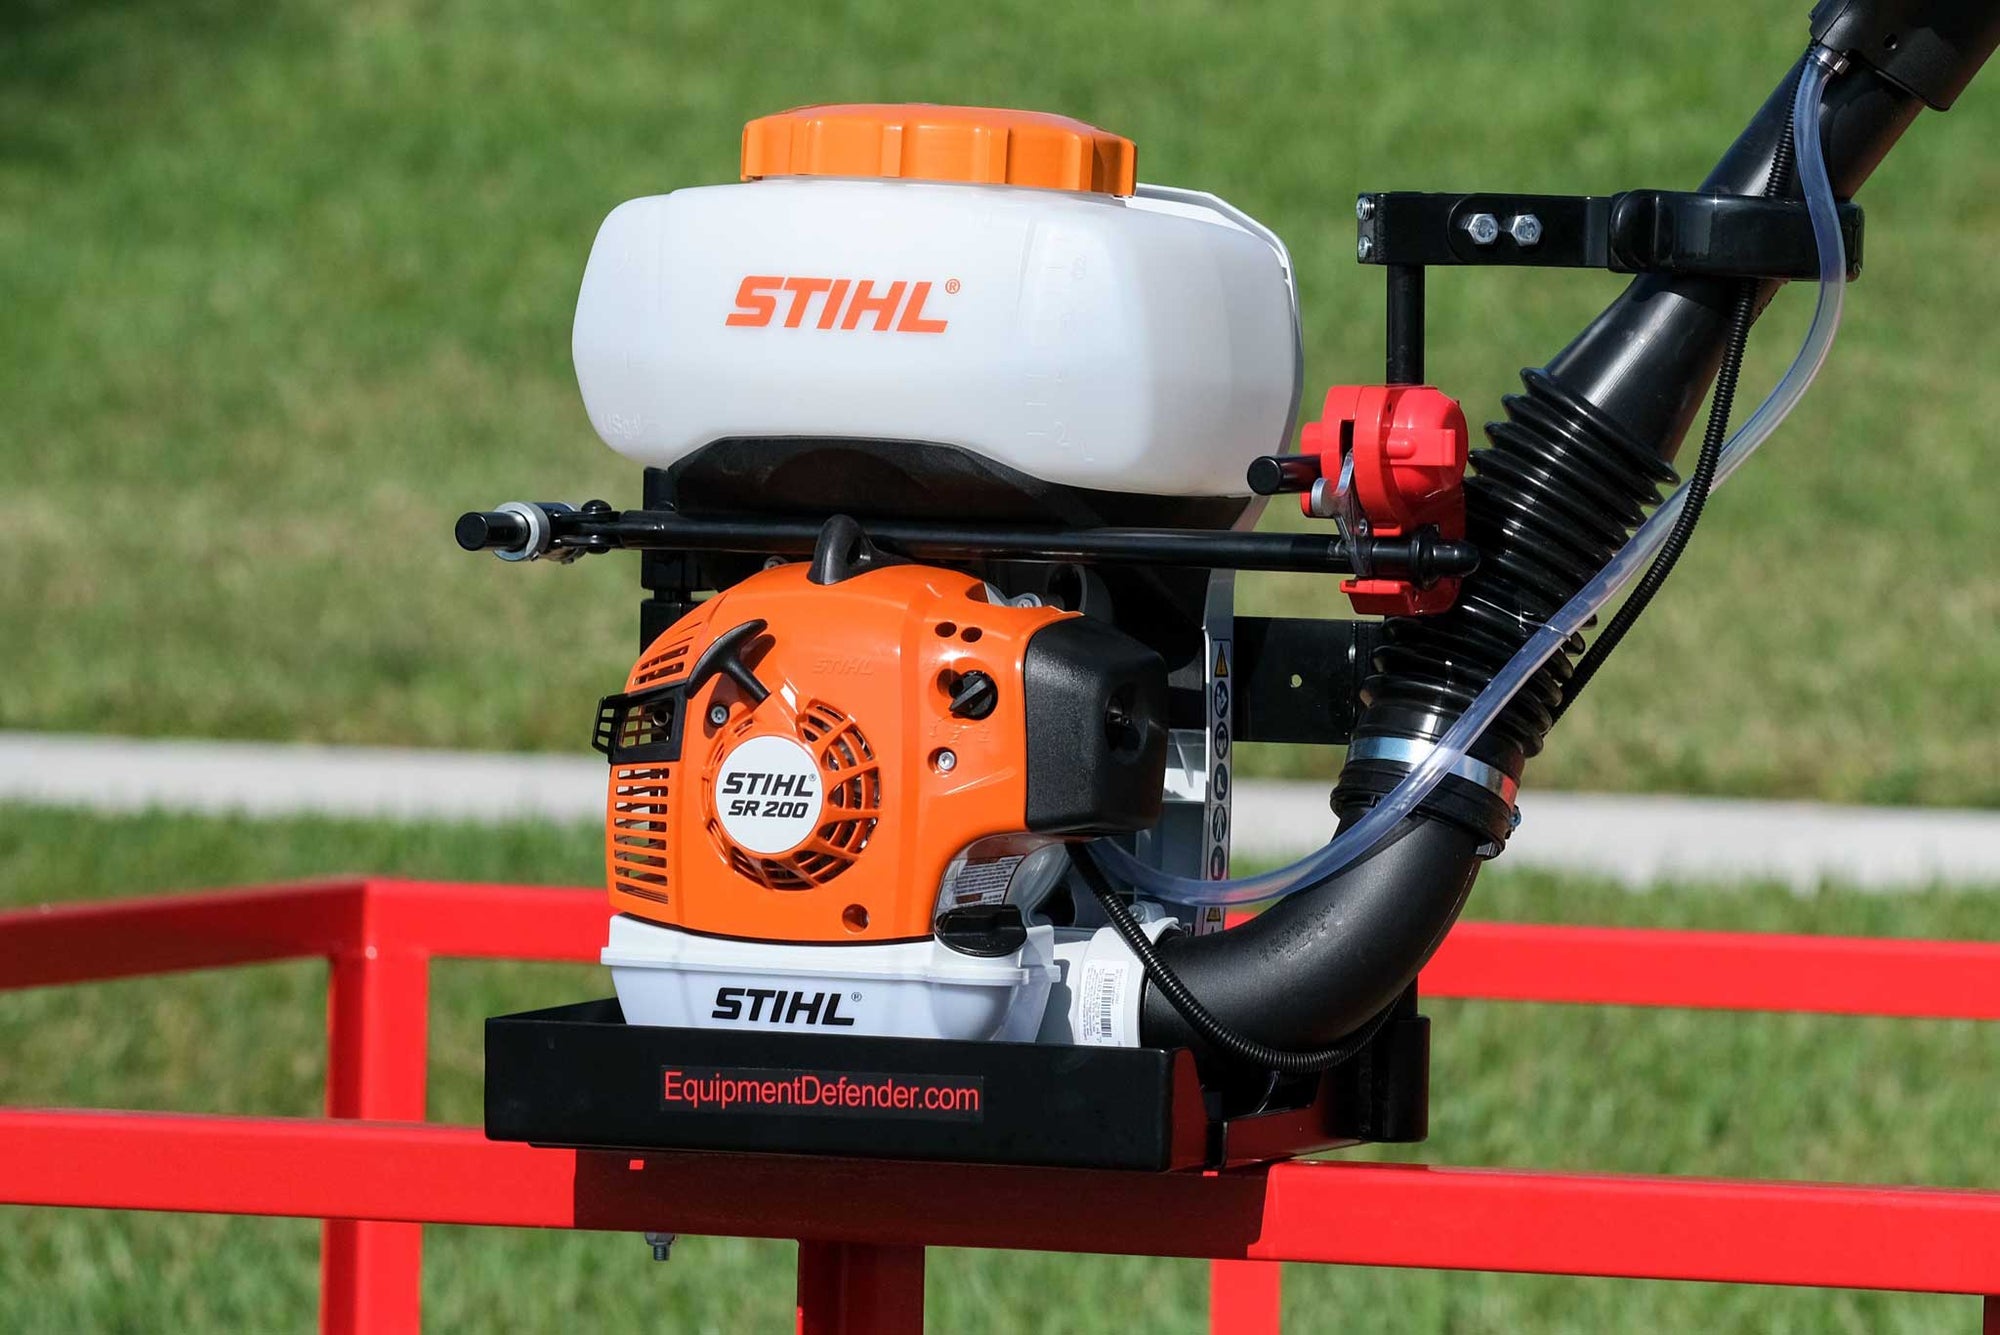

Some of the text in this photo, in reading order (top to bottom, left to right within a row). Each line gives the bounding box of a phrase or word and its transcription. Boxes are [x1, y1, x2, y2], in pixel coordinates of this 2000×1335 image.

[812, 656, 874, 677] STIHL
[728, 799, 809, 819] SR 200
[664, 1071, 979, 1112] EquipmentDefender.com
